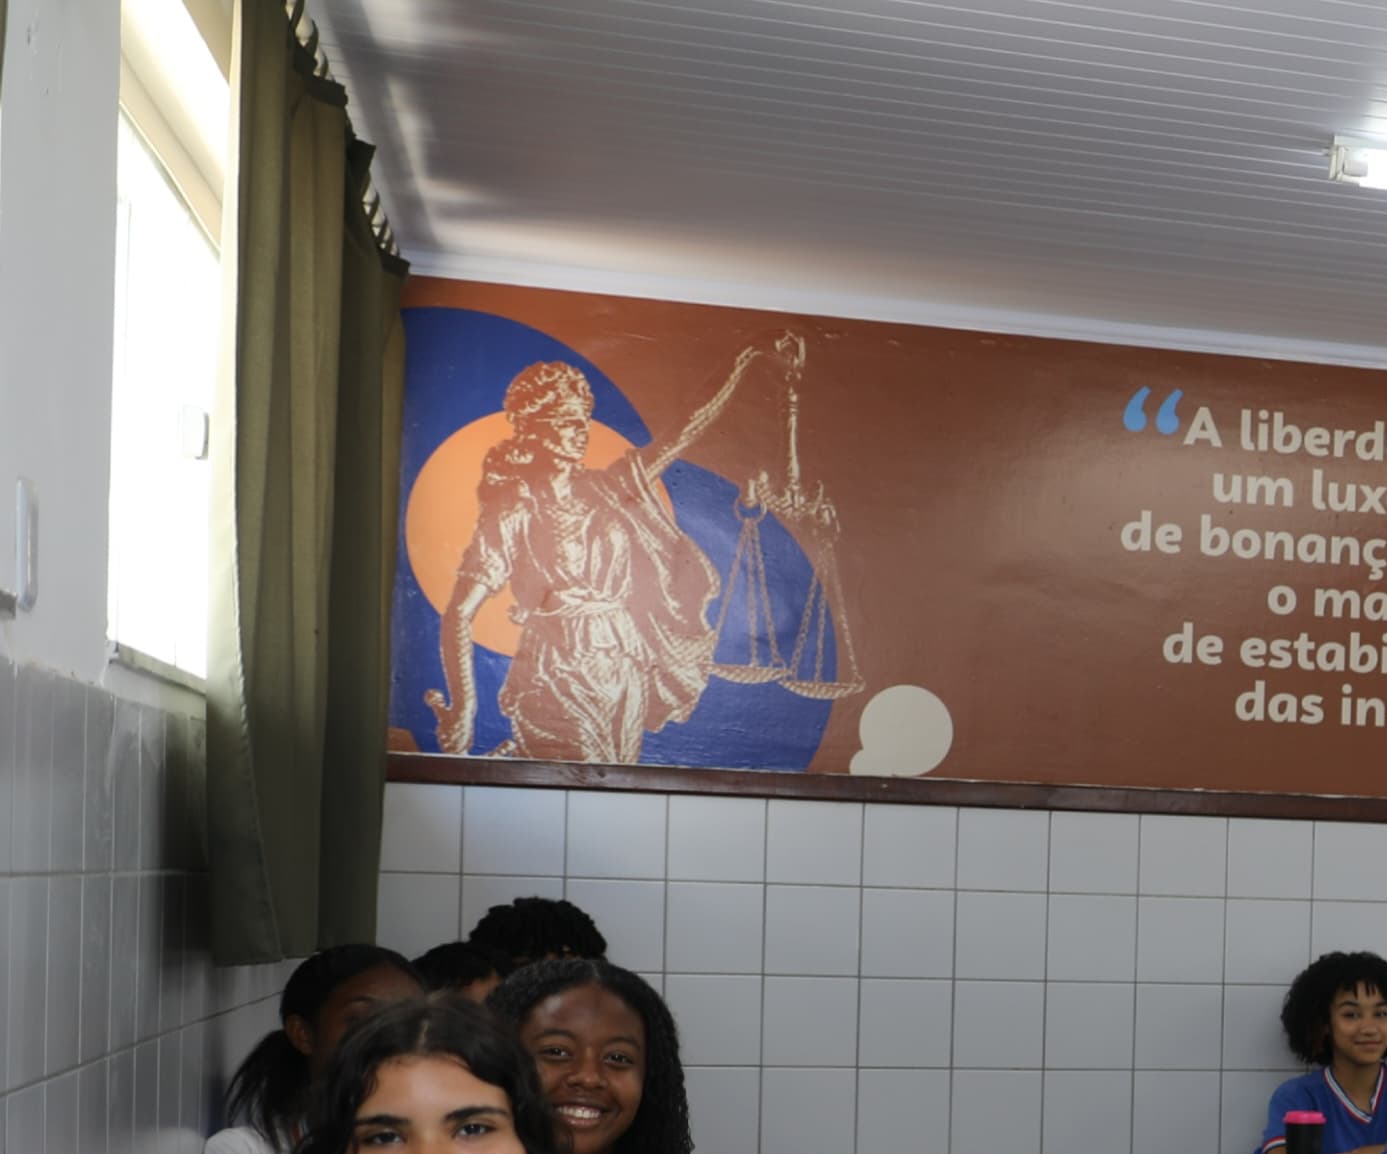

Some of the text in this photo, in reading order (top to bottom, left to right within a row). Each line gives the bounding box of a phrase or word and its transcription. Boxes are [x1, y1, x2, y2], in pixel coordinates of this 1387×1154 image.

[1213, 473, 1294, 507] um
[1120, 509, 1183, 554] de
[1267, 585, 1297, 615] o
[1162, 621, 1224, 666] de
[1235, 680, 1324, 725] das
